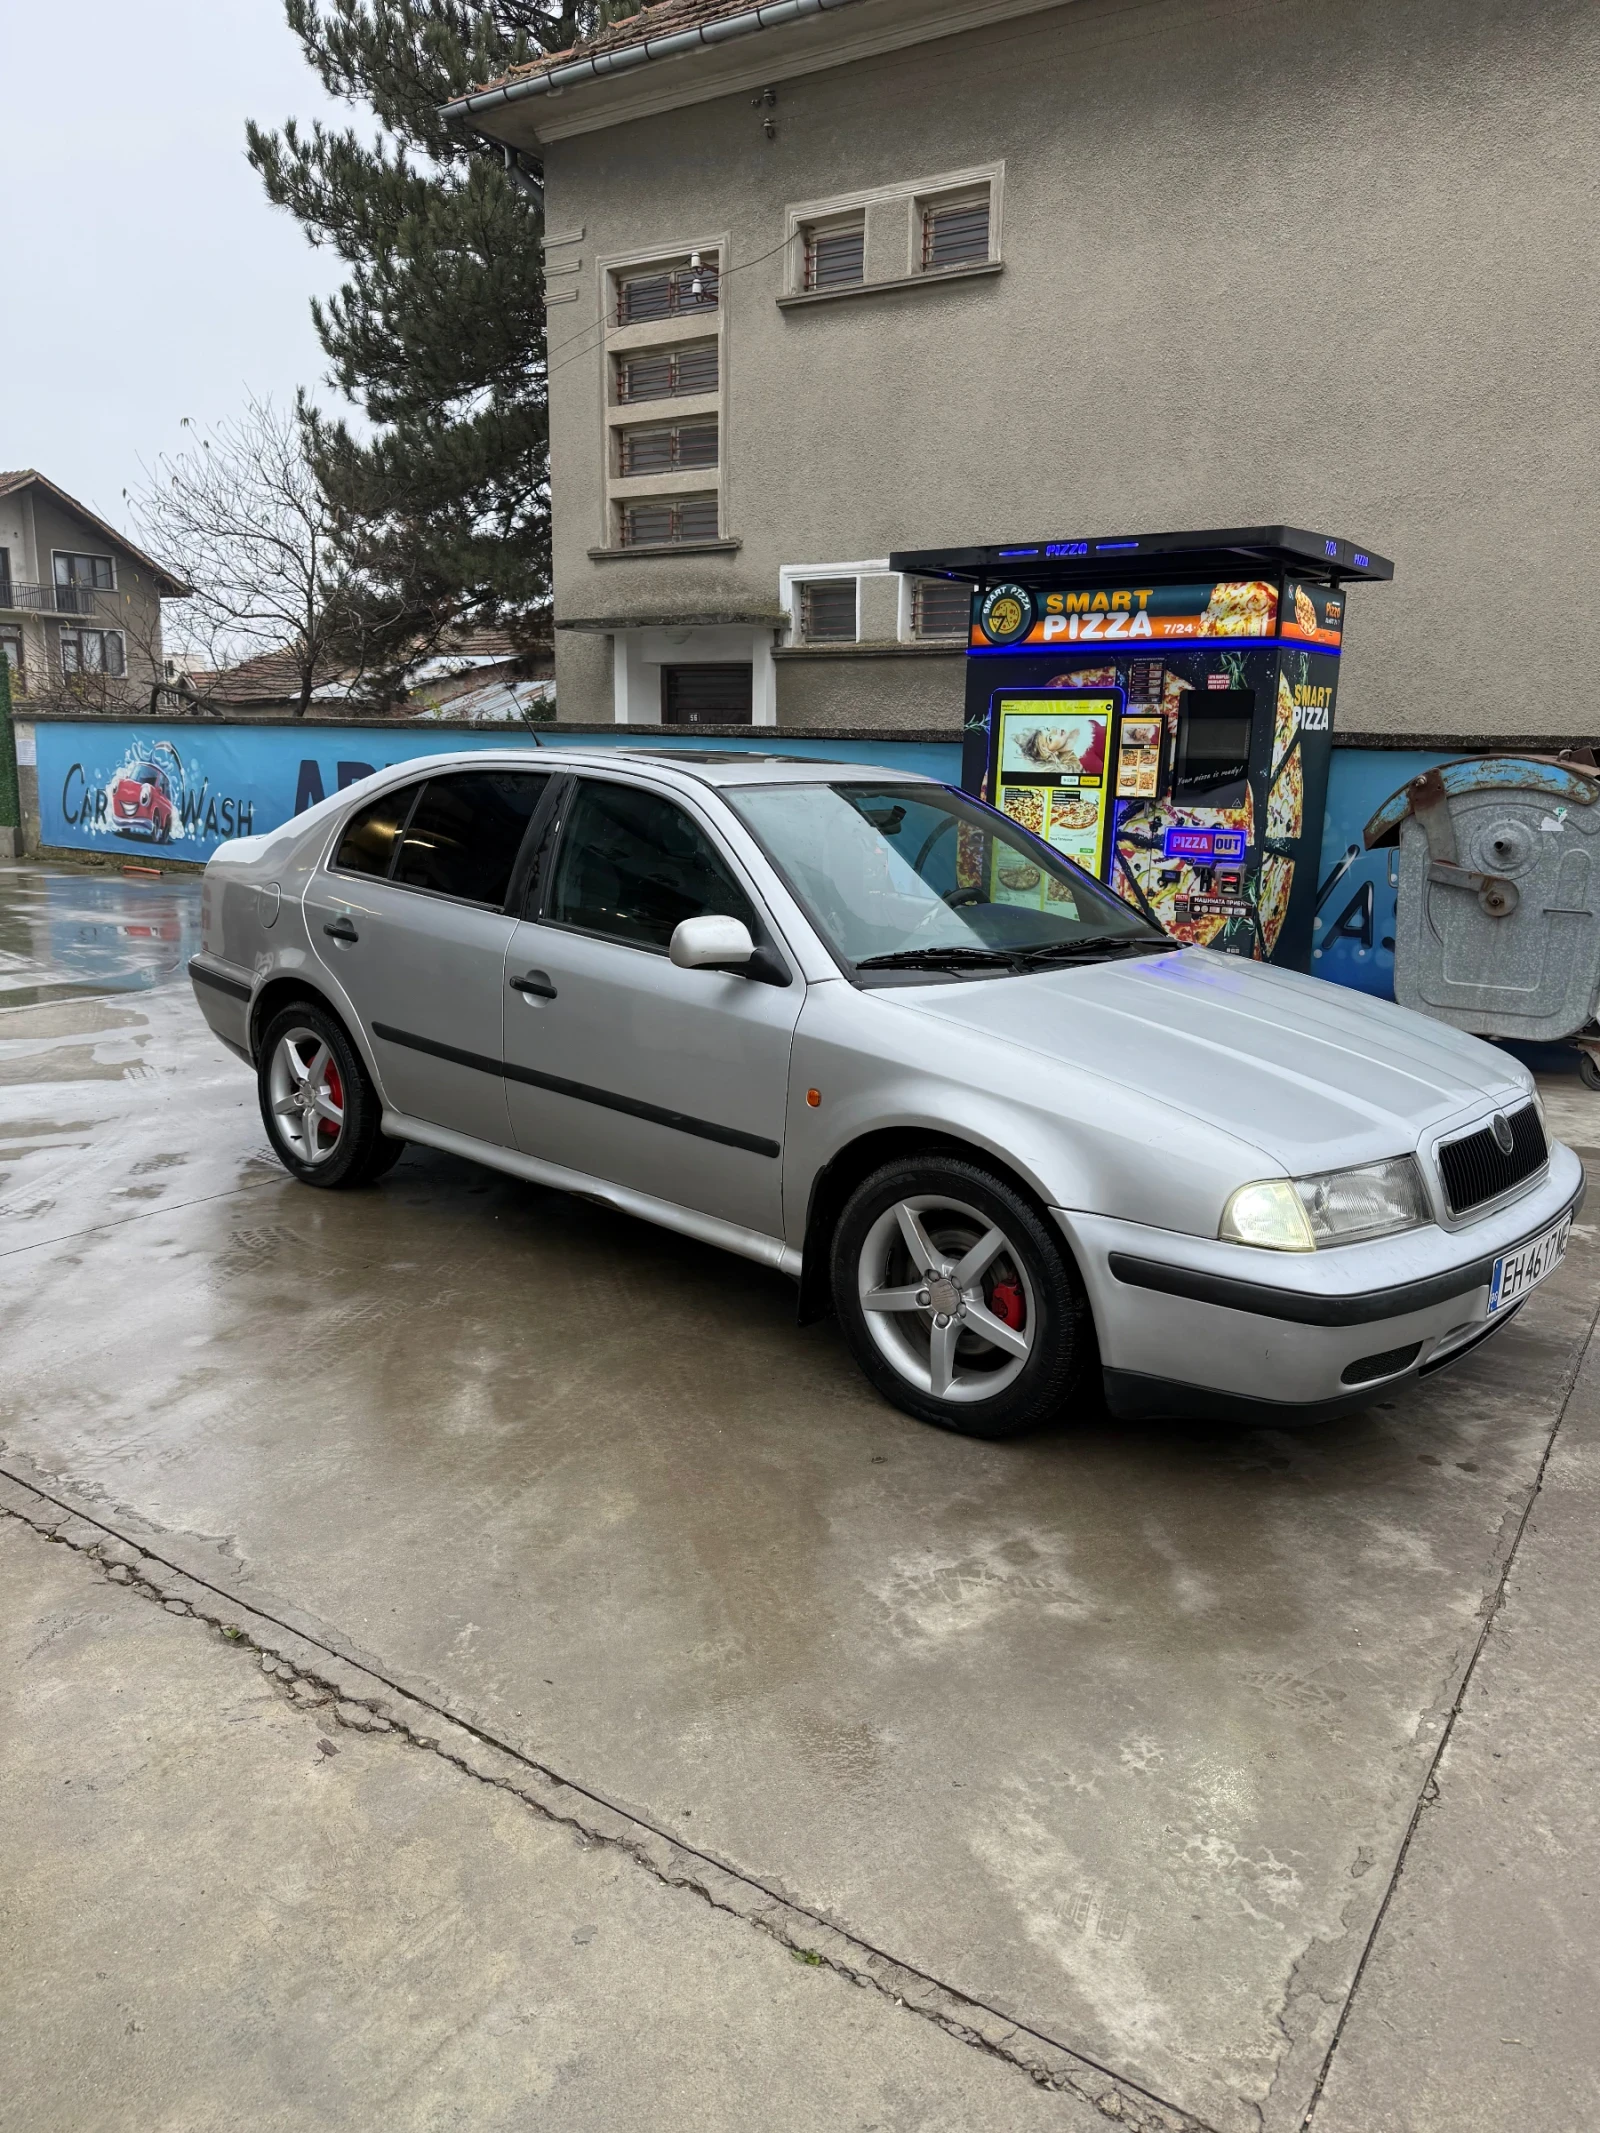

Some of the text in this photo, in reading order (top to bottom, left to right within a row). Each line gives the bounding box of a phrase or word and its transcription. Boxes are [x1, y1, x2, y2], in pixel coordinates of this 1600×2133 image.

[984, 586, 1031, 614] SMART PIZZA
[1046, 589, 1154, 614] SMART
[1043, 610, 1153, 641] PIZZA
[1163, 623, 1193, 635] 7/24
[1294, 684, 1332, 707] SMART
[1293, 706, 1329, 731] PIZZA
[1193, 773, 1211, 784] pizza
[1212, 770, 1220, 778] is
[1220, 765, 1244, 777] ready!
[62, 763, 107, 825] CAR
[180, 776, 255, 839] WASH
[1172, 836, 1241, 851] PIZZA OUT
[1501, 1252, 1526, 1299] EH
